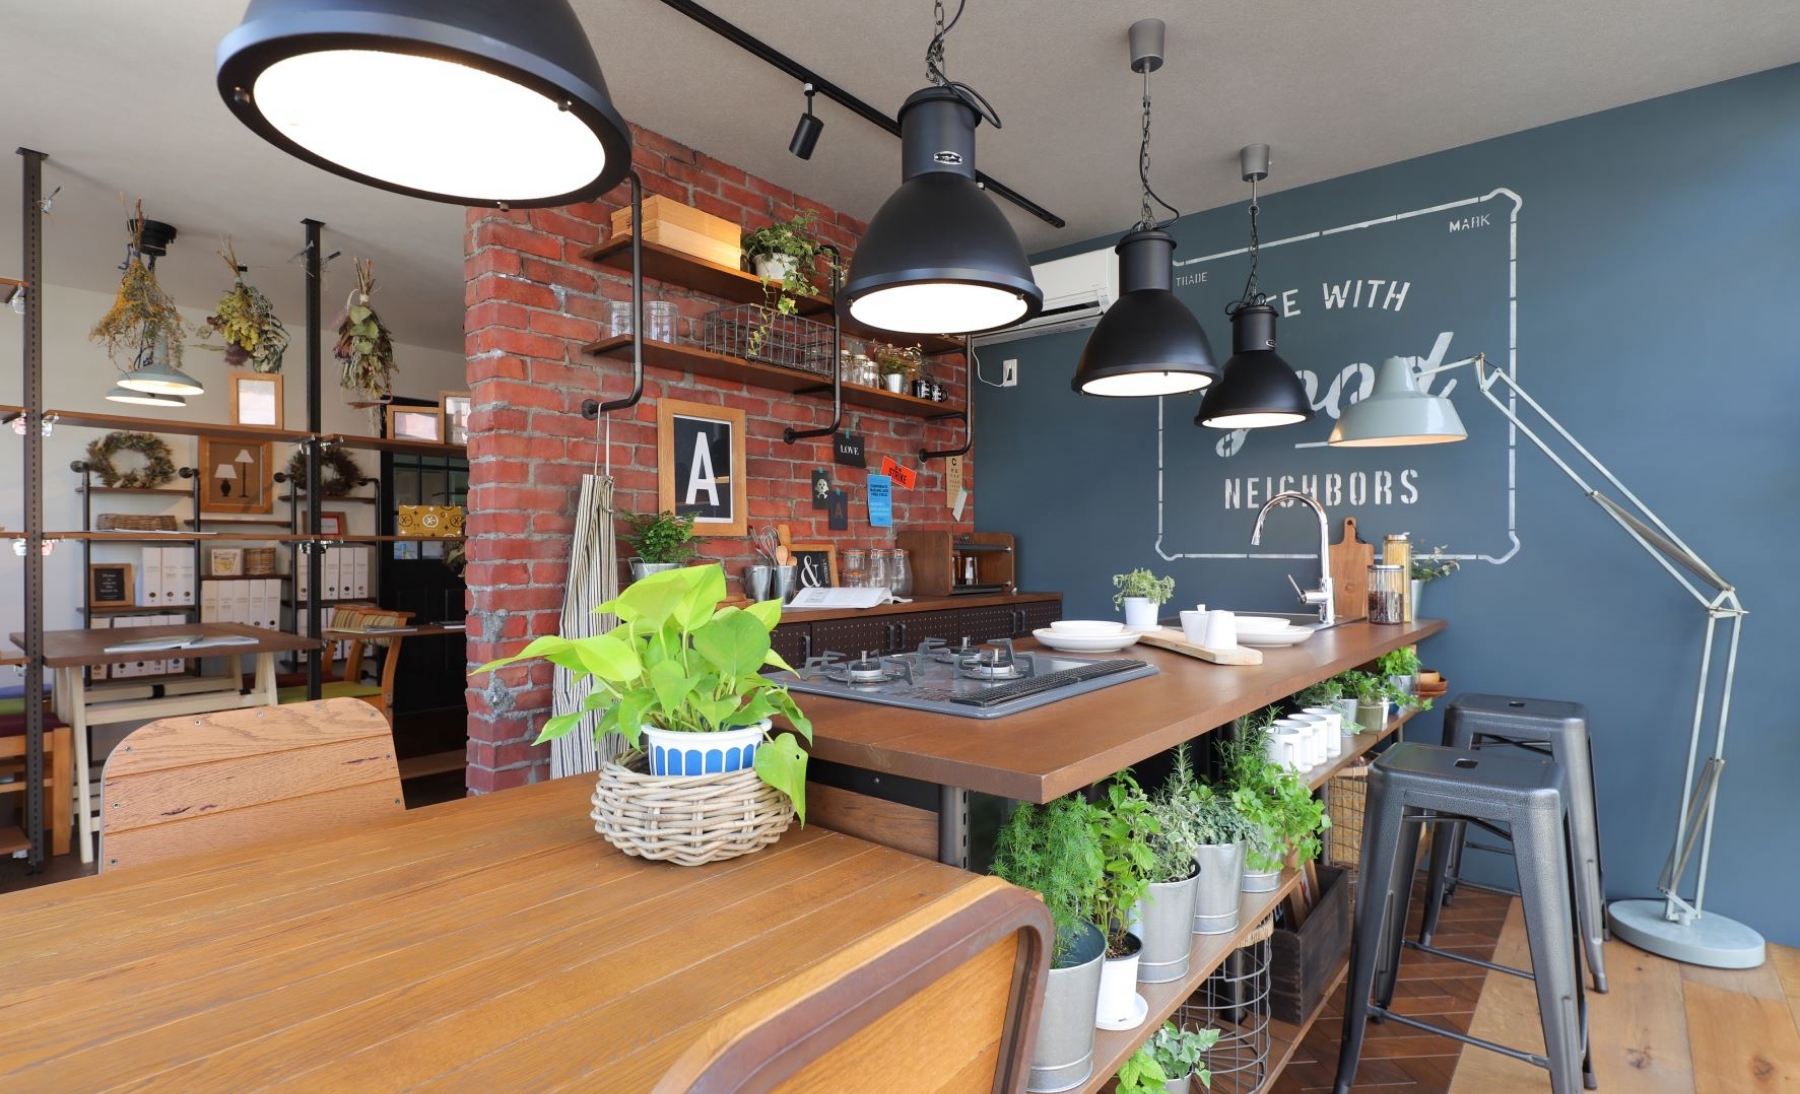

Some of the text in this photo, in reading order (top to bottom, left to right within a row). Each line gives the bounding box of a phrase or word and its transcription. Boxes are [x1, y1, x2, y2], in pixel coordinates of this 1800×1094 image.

[1449, 213, 1491, 233] MARK
[1322, 279, 1411, 312] WITH
[840, 444, 860, 456] LOVE
[685, 431, 720, 506] A
[1224, 469, 1419, 509] NEIGHBORS
